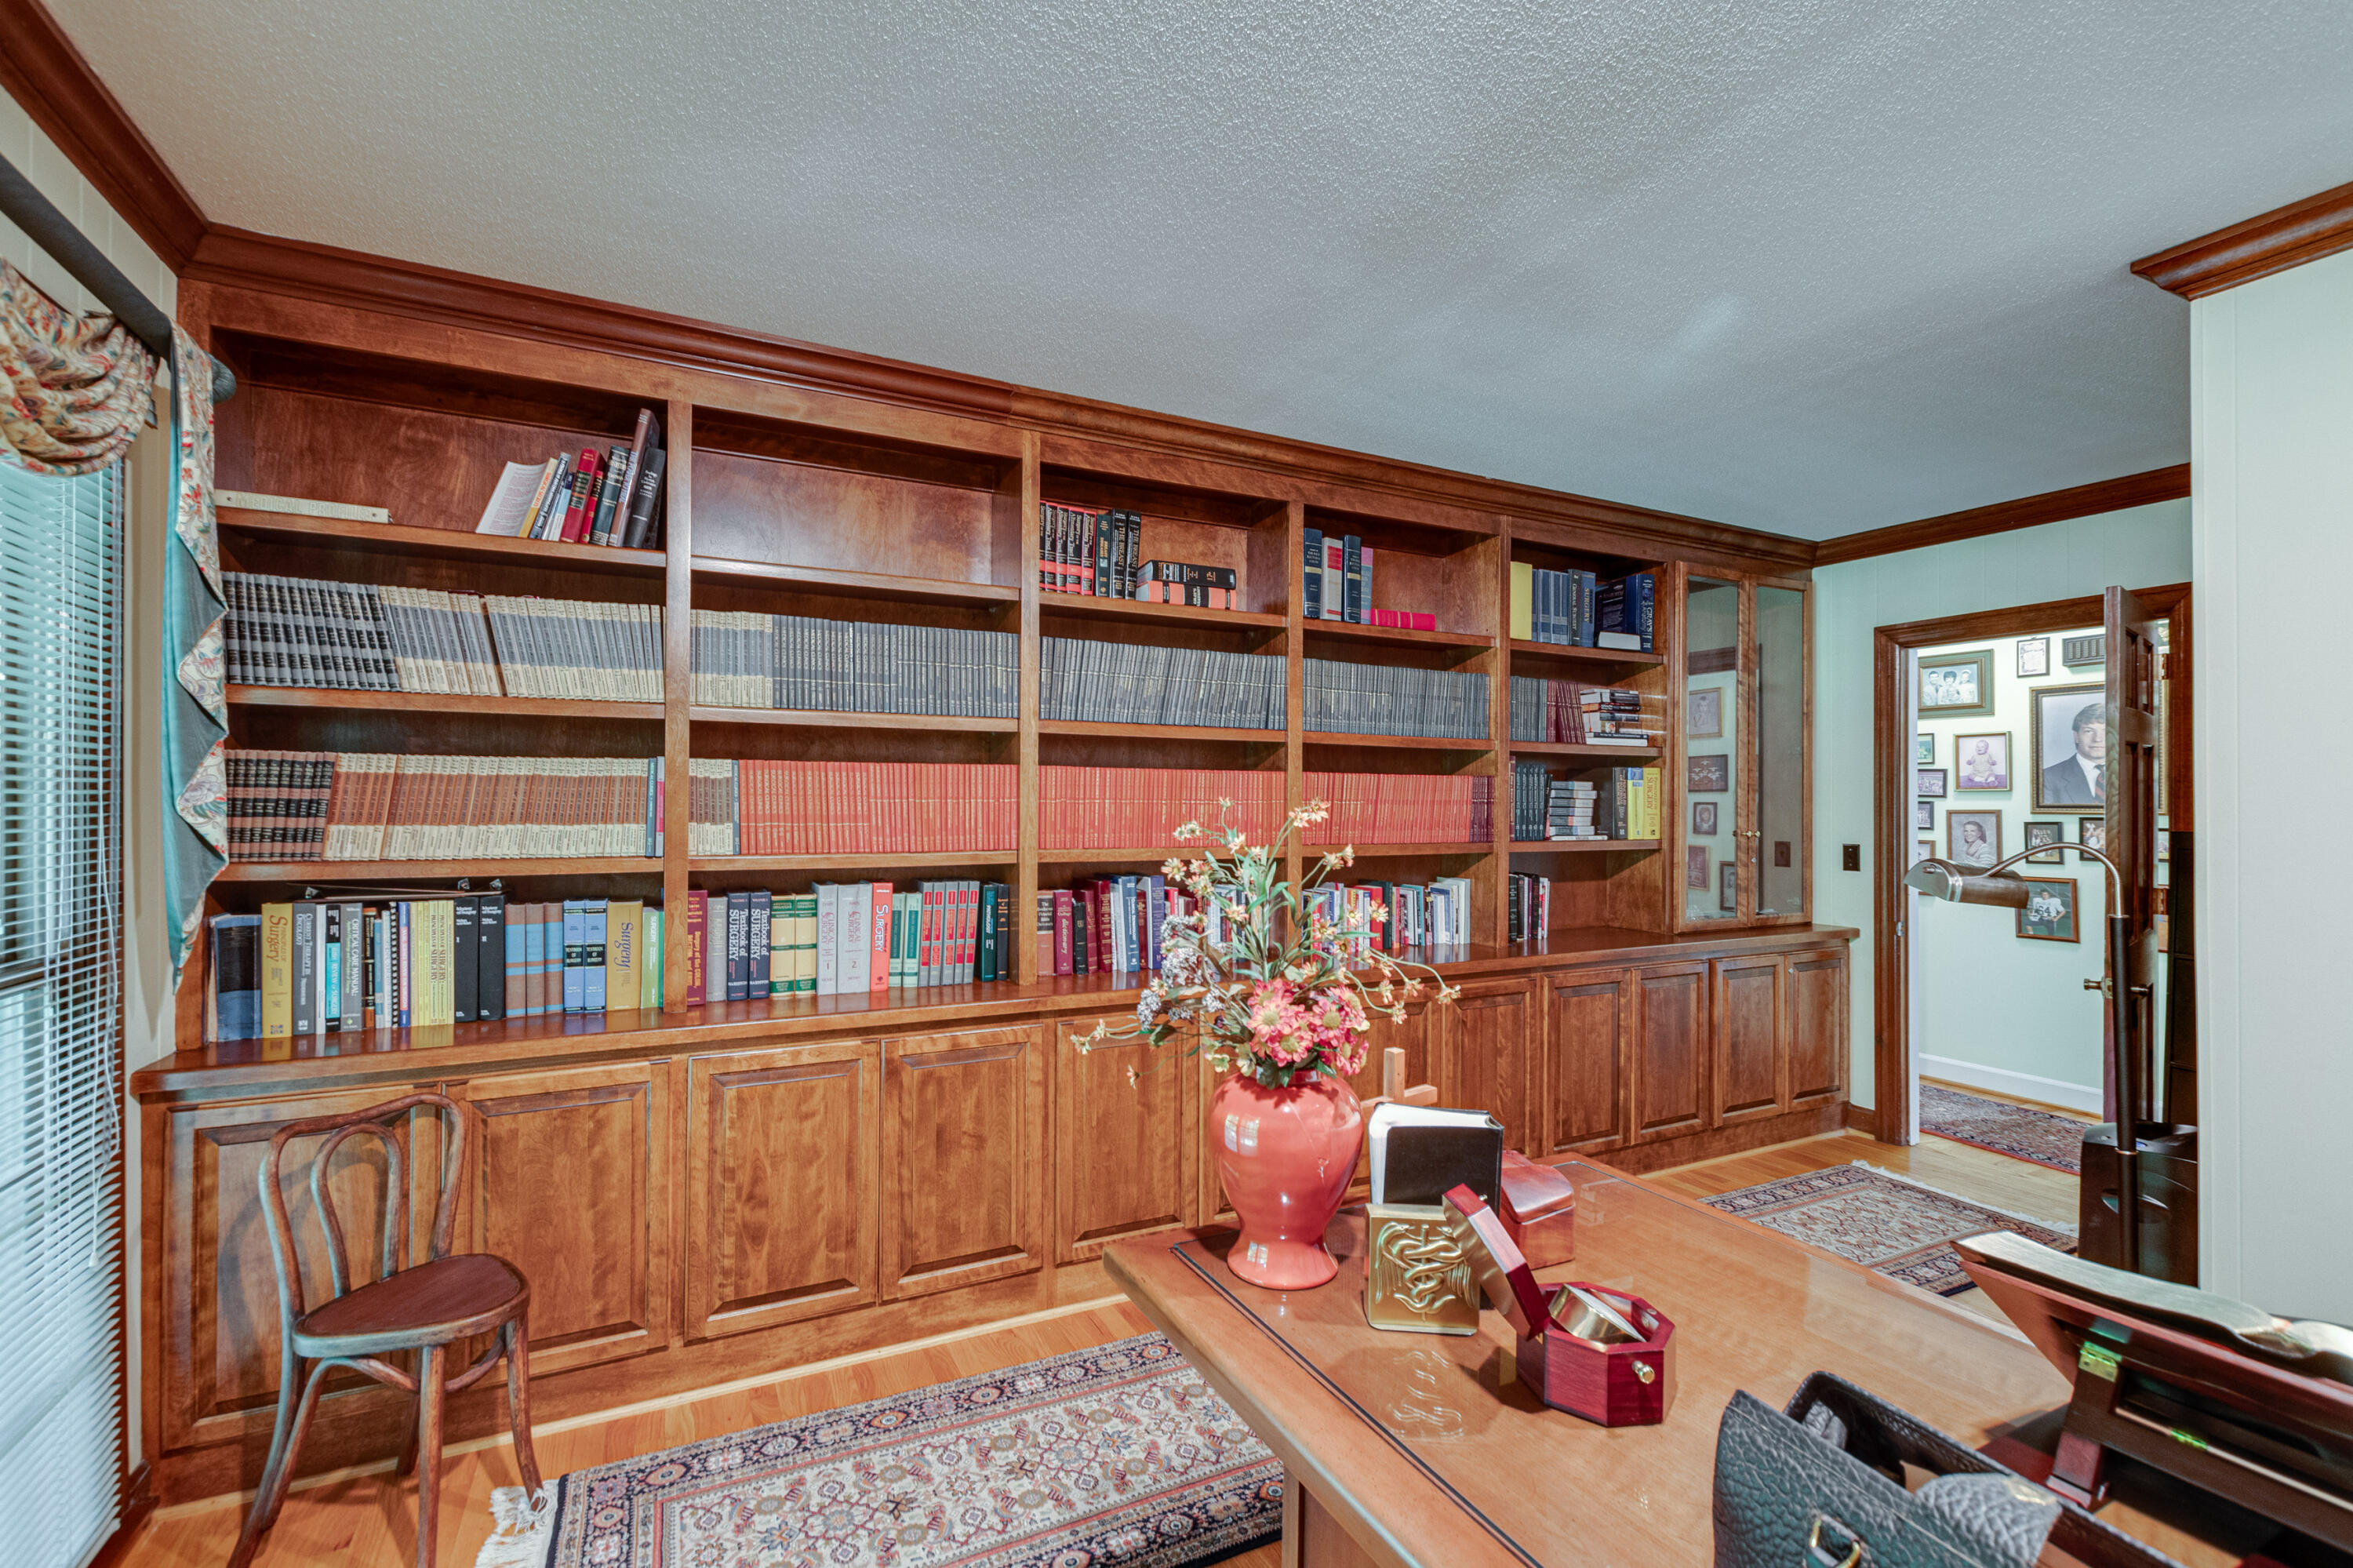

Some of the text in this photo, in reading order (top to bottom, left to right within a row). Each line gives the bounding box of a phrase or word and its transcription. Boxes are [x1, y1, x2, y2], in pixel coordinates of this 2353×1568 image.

[267, 915, 288, 962] Surgery
[614, 922, 634, 968] Surgery
[729, 910, 739, 960] SURGERY
[739, 908, 748, 956] Textbook of
[751, 908, 761, 960] SURGERY
[761, 908, 769, 946] Textbook
[875, 904, 889, 952] SURGERY
[304, 942, 313, 968] THERAPY
